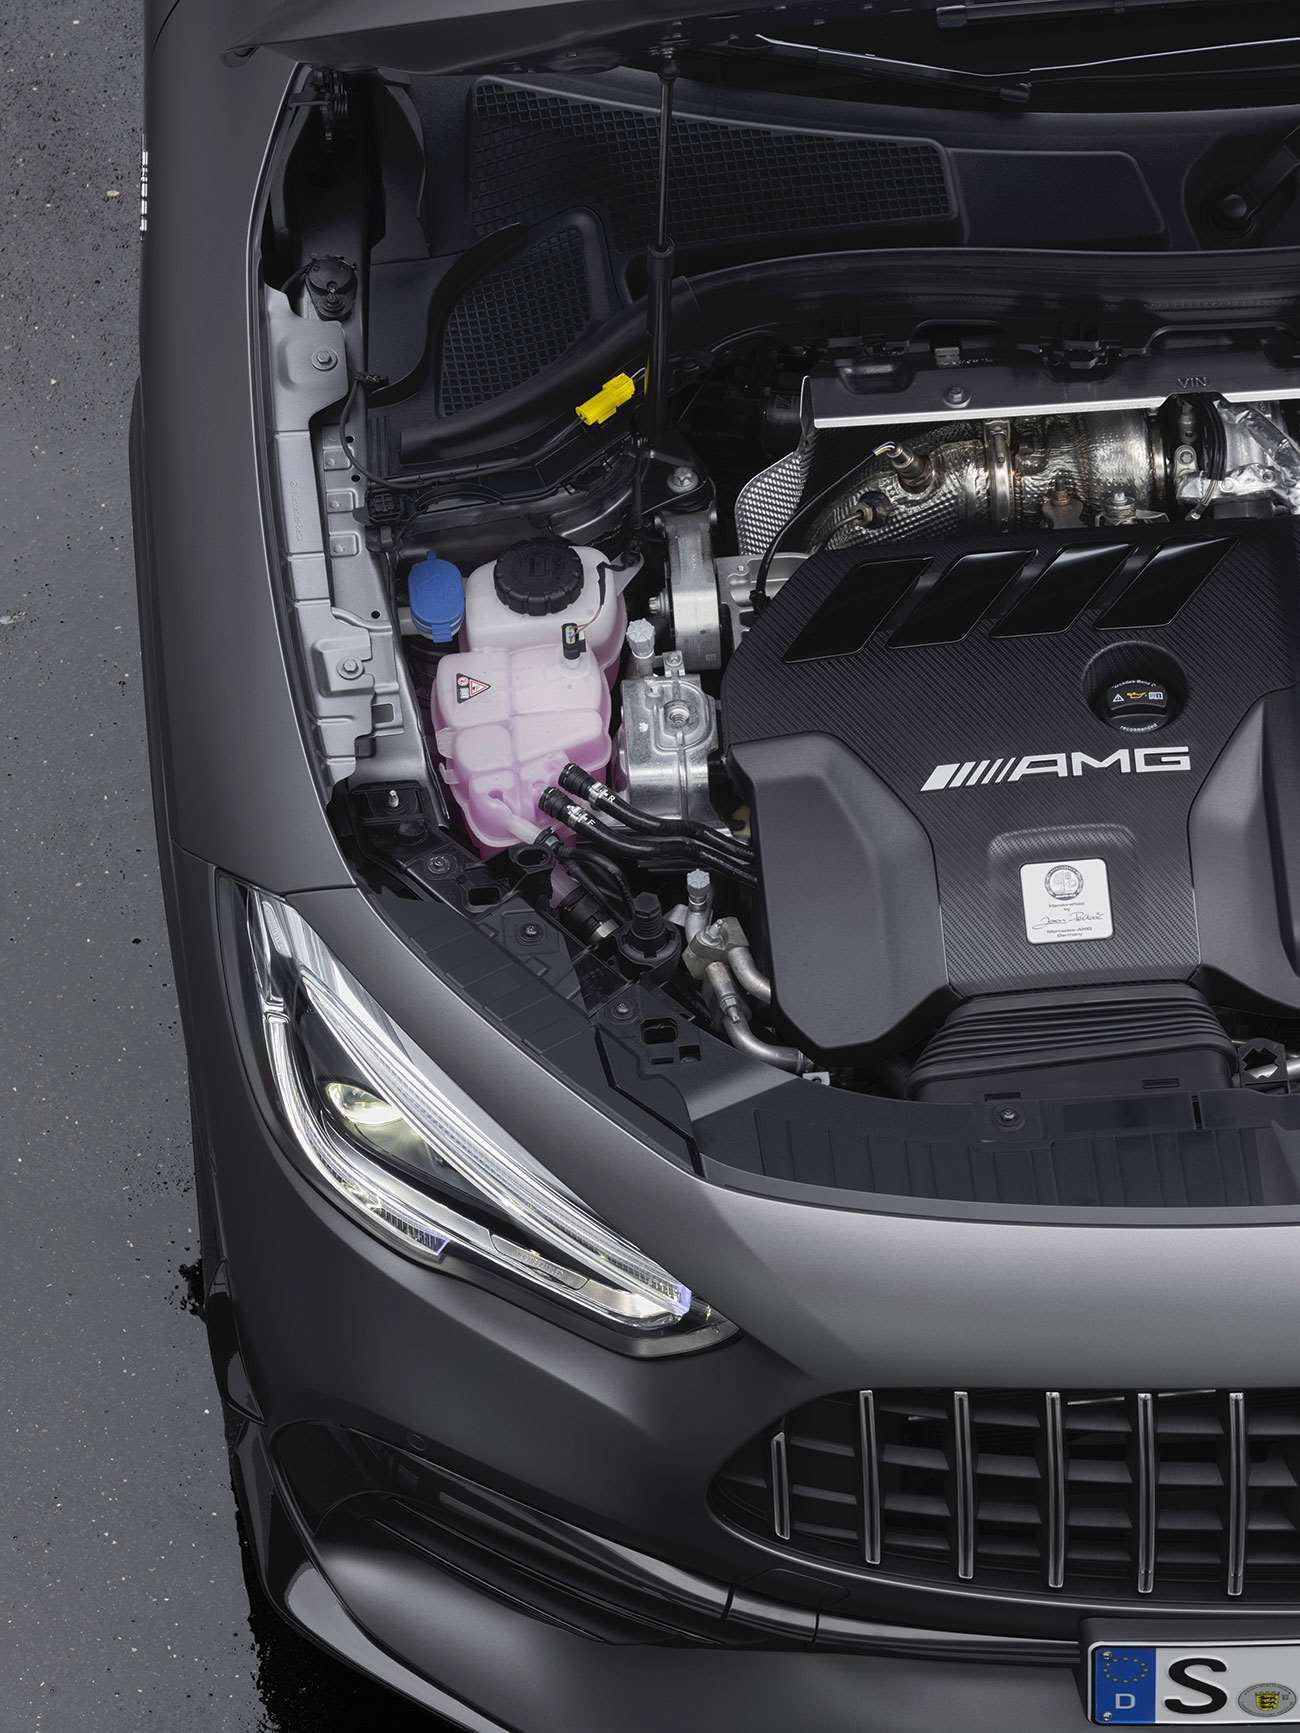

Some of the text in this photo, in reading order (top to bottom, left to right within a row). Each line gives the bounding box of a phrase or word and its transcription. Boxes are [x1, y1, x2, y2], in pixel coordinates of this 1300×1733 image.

[1177, 376, 1207, 388] VIN
[1008, 746, 1192, 783] AMG
[607, 795, 616, 803] R
[587, 819, 596, 827] F
[1164, 1657, 1228, 1715] S
[1115, 1693, 1136, 1710] D
